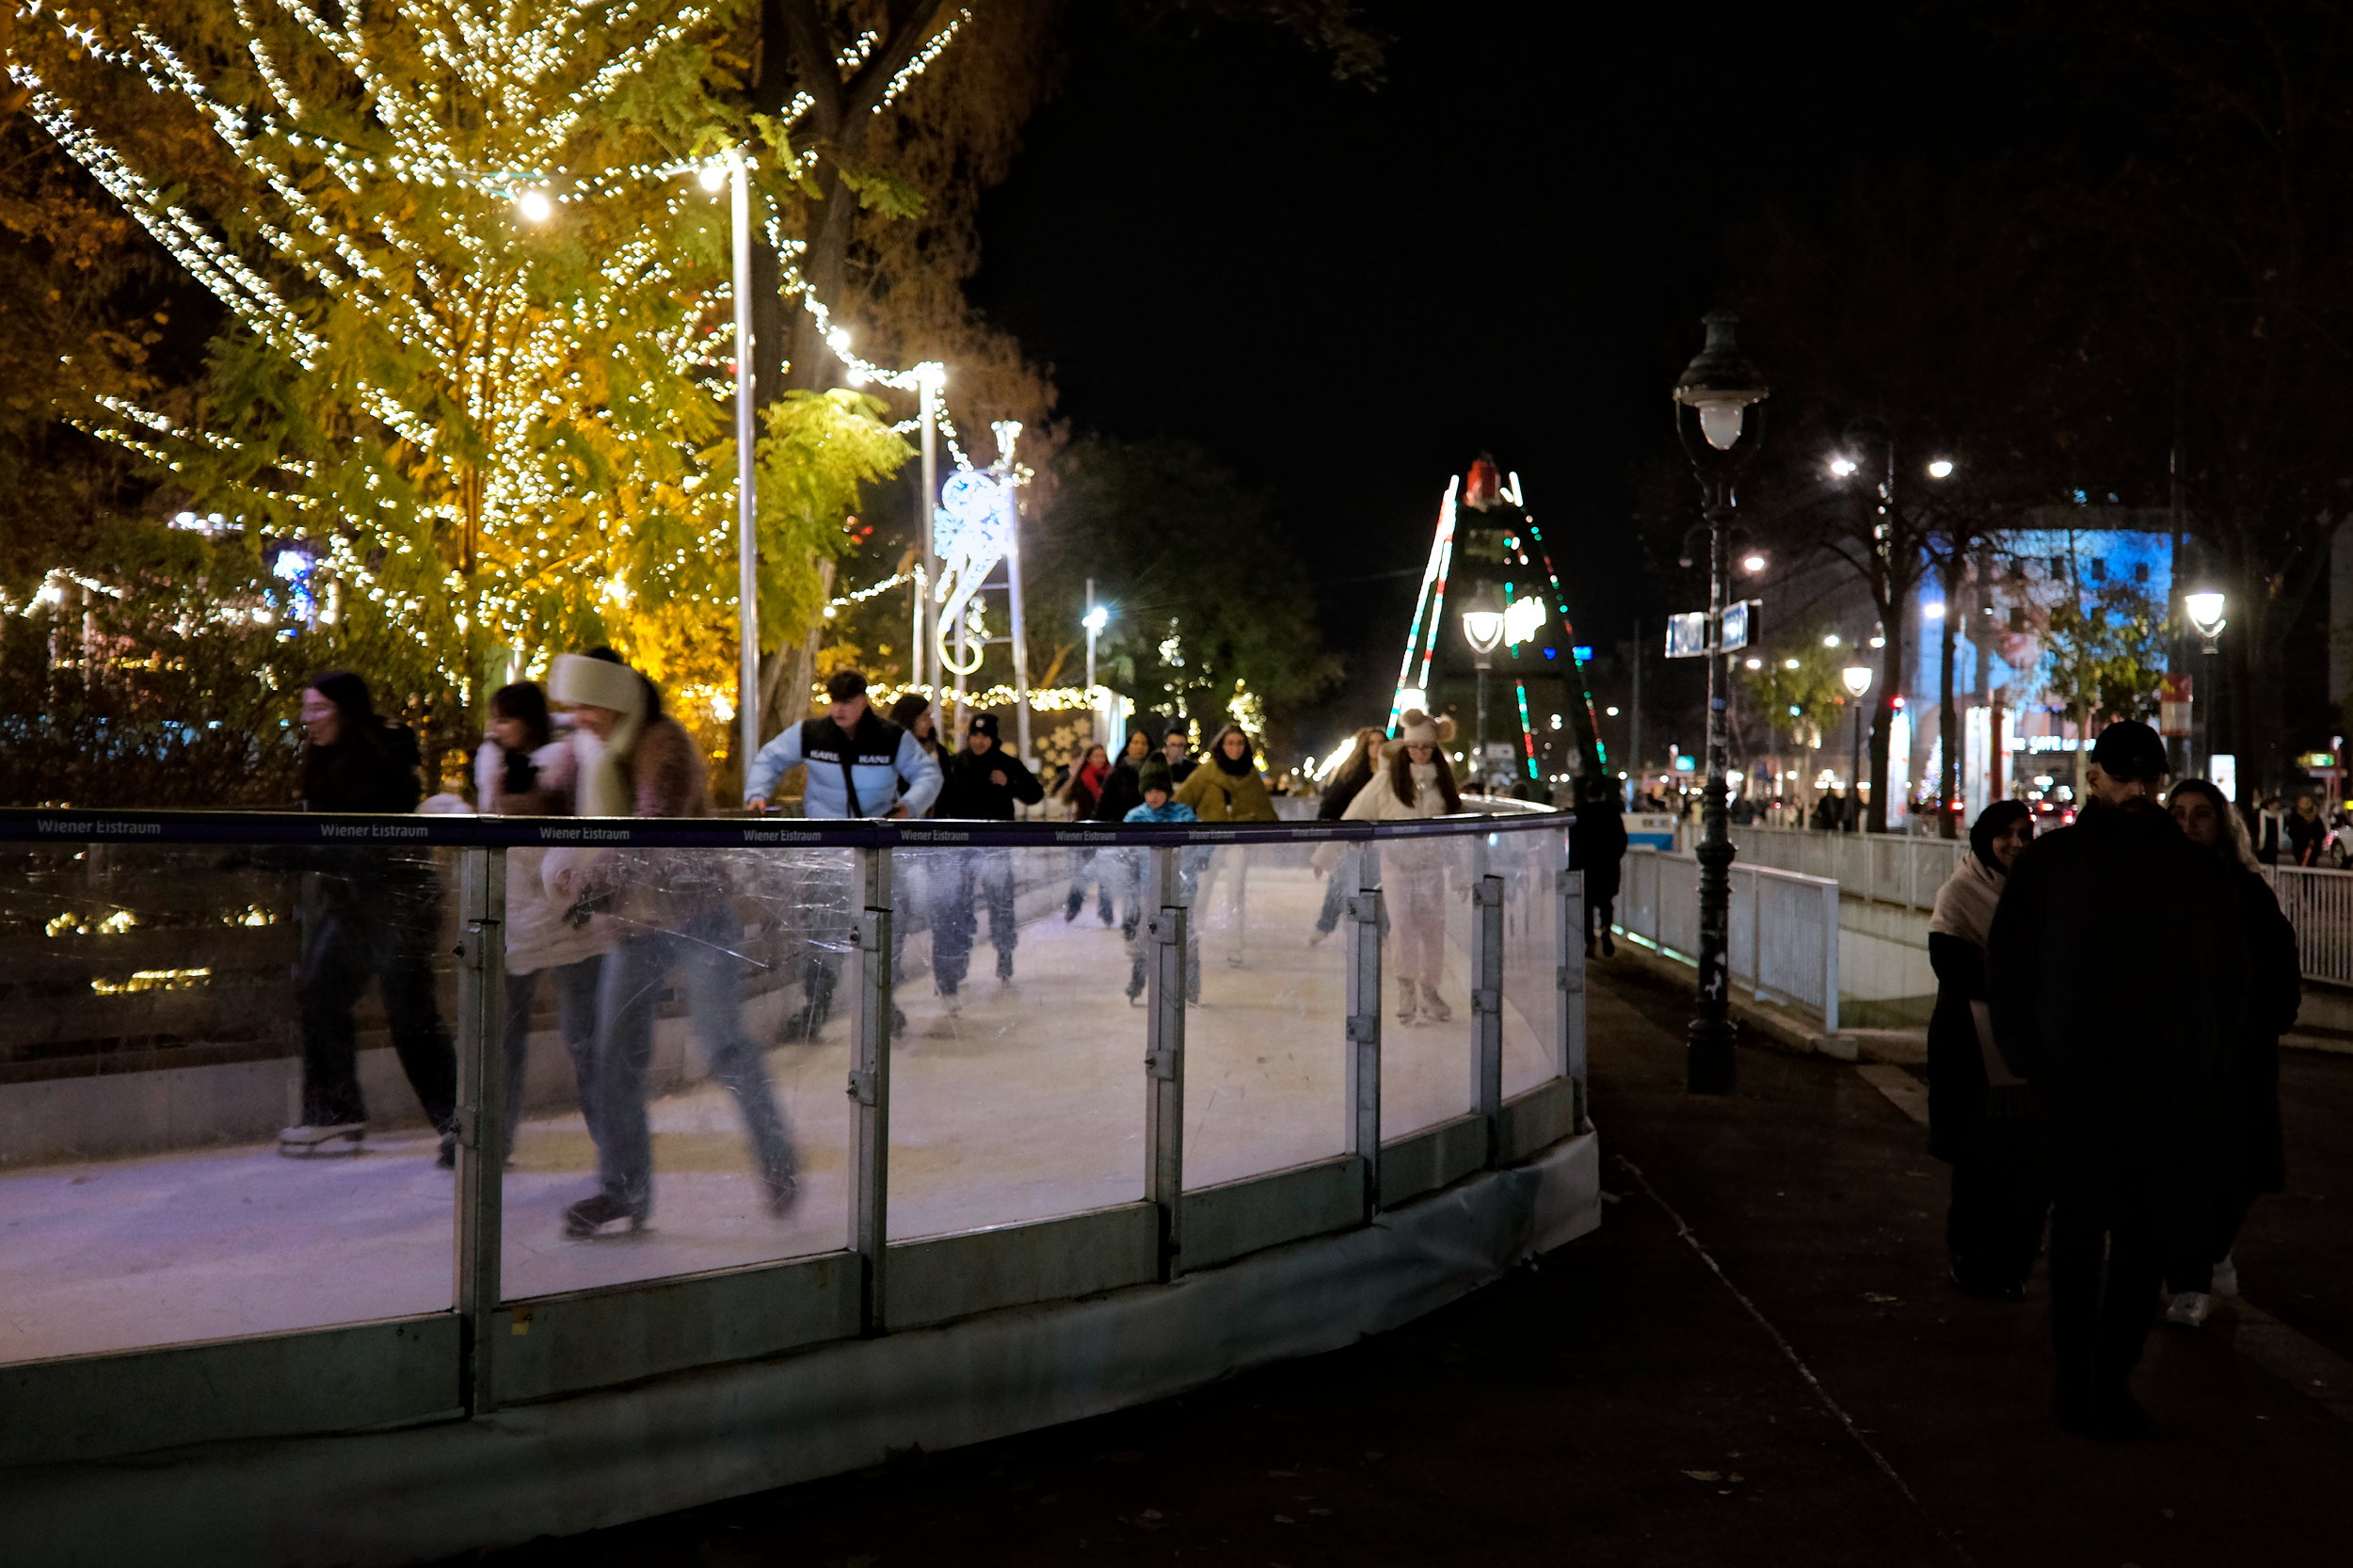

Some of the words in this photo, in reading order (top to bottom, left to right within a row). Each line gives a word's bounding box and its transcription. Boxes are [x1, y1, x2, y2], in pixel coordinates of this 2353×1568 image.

[37, 819, 93, 834] Wiener
[96, 819, 161, 835] Eistraum
[320, 824, 369, 837] Wiener
[372, 824, 428, 838] Eistraum
[539, 826, 581, 840] Wiener
[583, 826, 630, 840] Eistraum
[743, 829, 779, 841] Wiener
[780, 829, 822, 842] Eistraum
[900, 829, 932, 841] Wiener
[933, 829, 969, 841] Eistraum
[1055, 830, 1083, 841] Wiener
[1084, 830, 1116, 842] Eistraum
